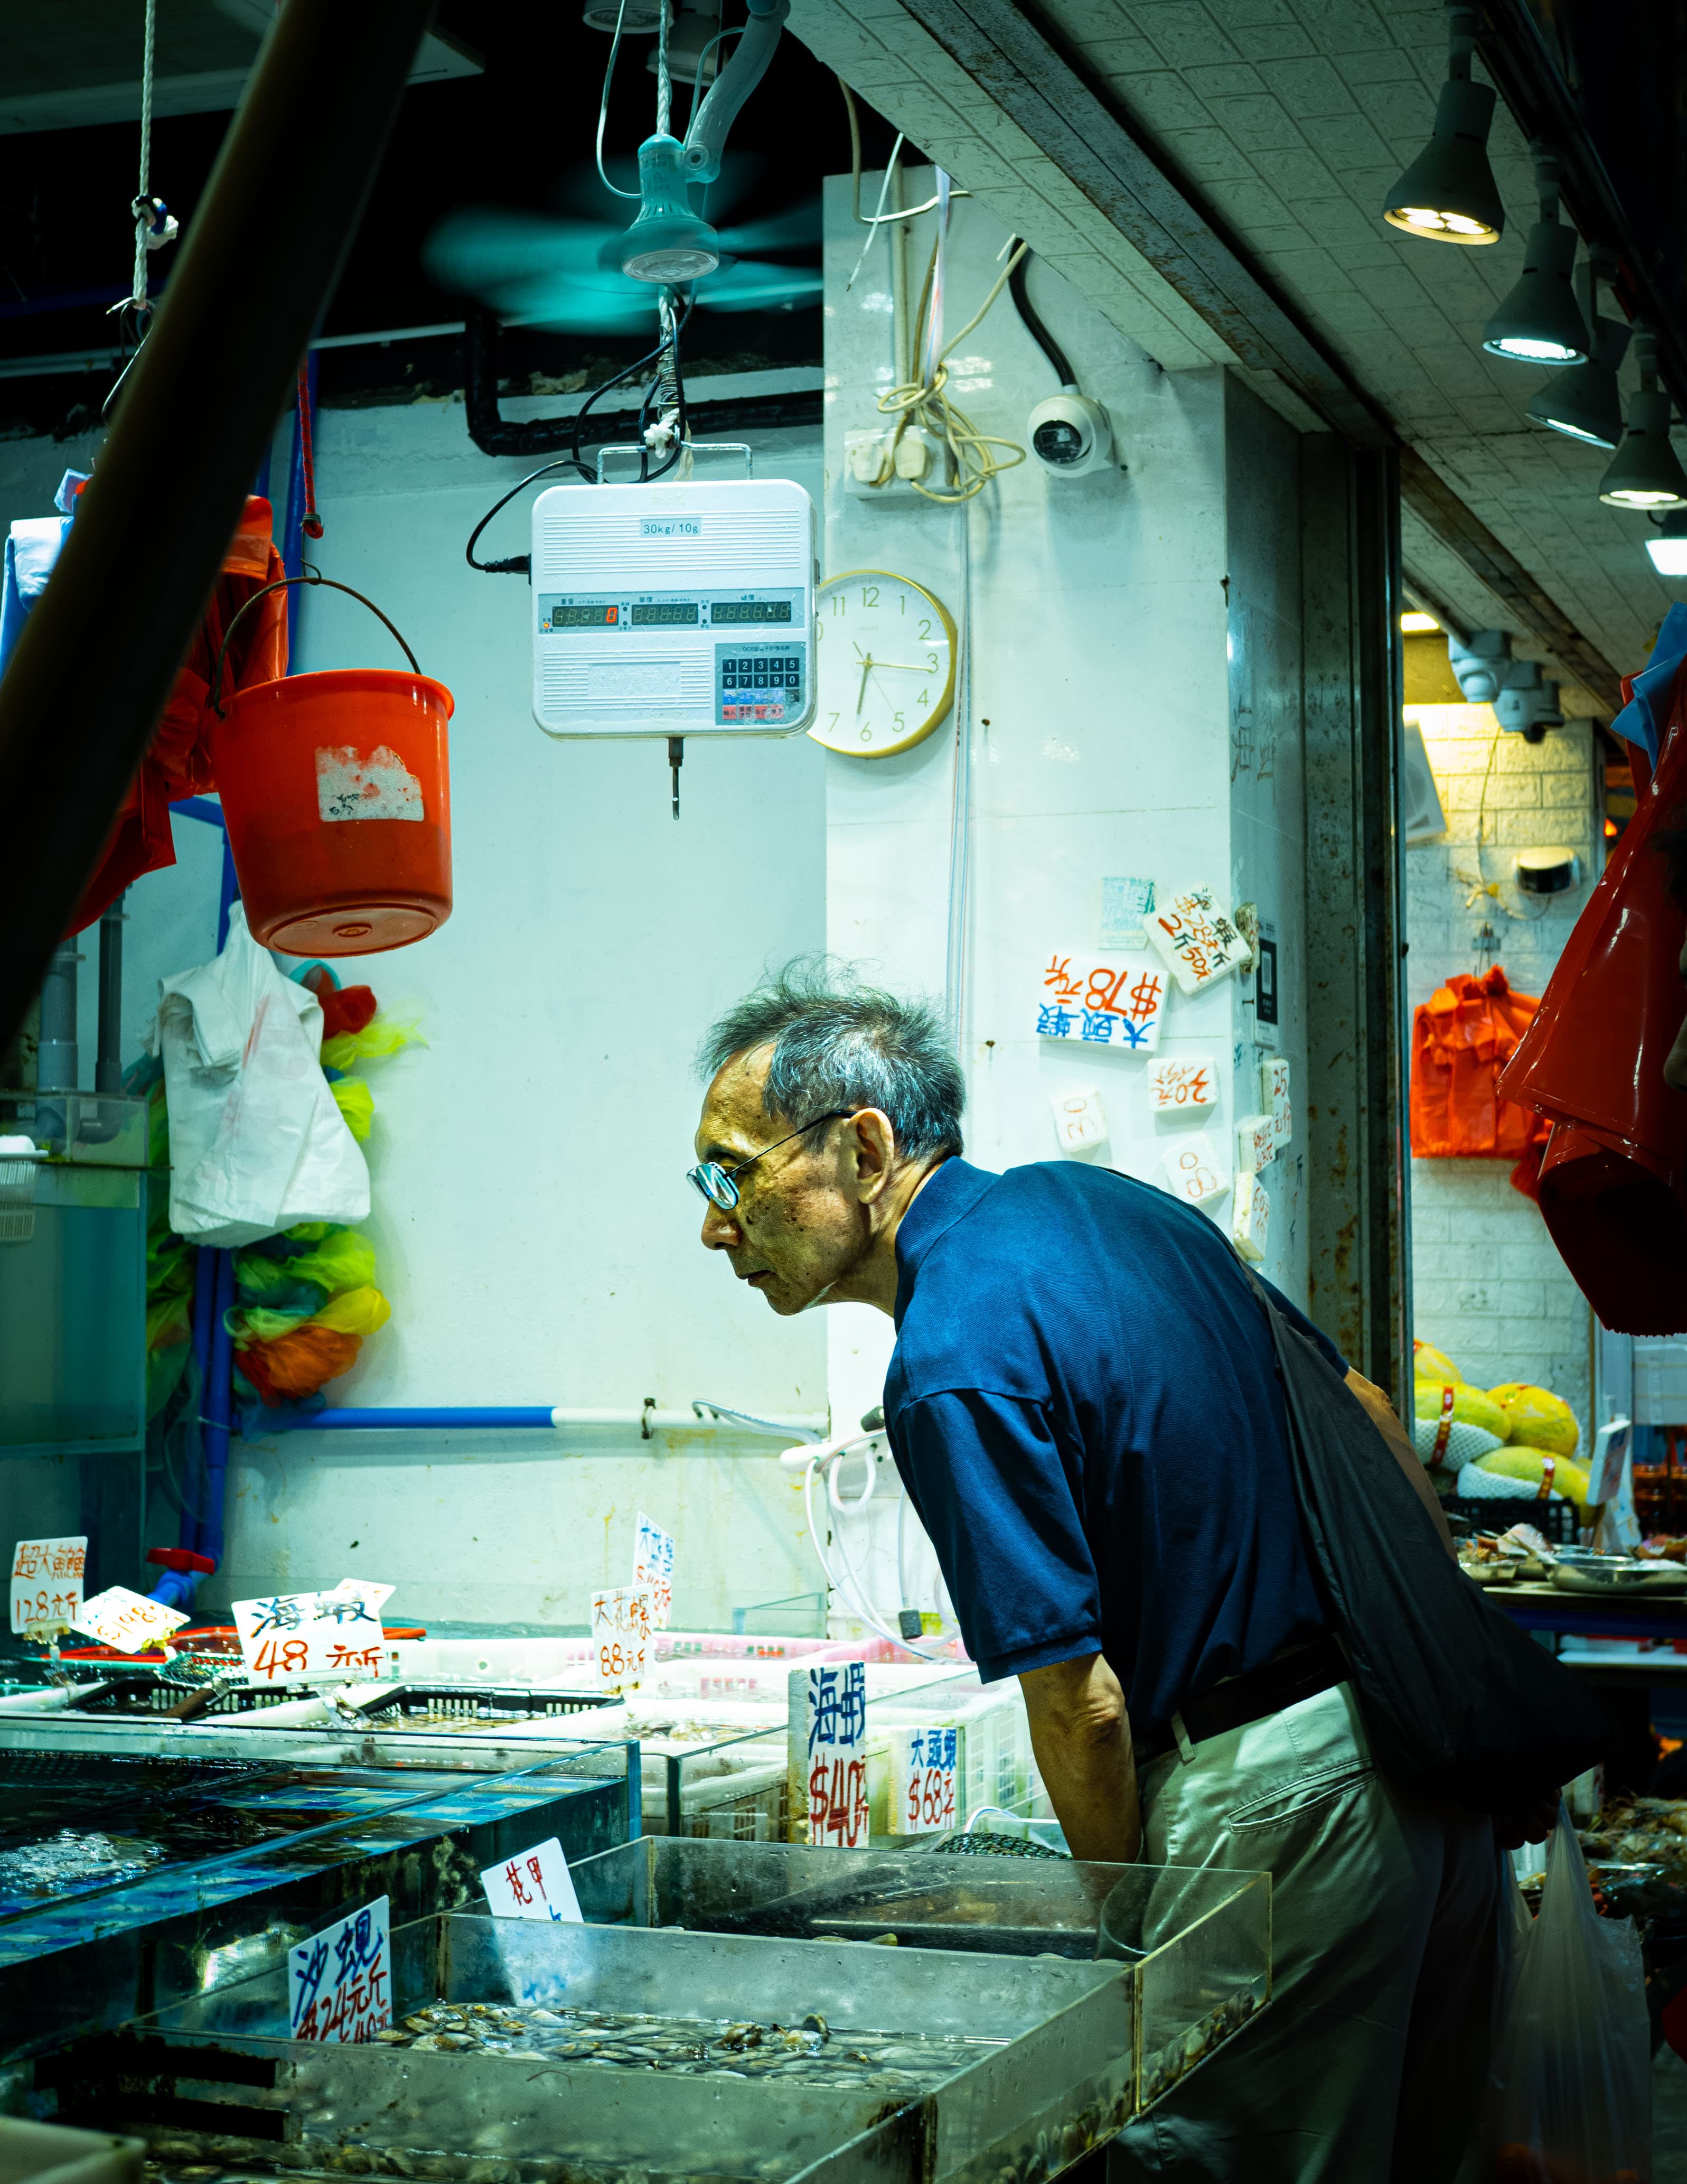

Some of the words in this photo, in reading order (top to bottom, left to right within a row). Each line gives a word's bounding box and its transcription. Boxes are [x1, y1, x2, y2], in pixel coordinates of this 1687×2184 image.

[831, 596, 845, 616] 11
[861, 587, 879, 608] 12
[899, 595, 905, 615] 1
[919, 619, 931, 640] 2
[743, 661, 748, 670] 2
[927, 653, 939, 674] 3
[790, 676, 795, 684] 0
[916, 688, 929, 707] 4
[828, 713, 840, 733] 7
[860, 722, 871, 742] 6
[892, 712, 904, 732] 5
